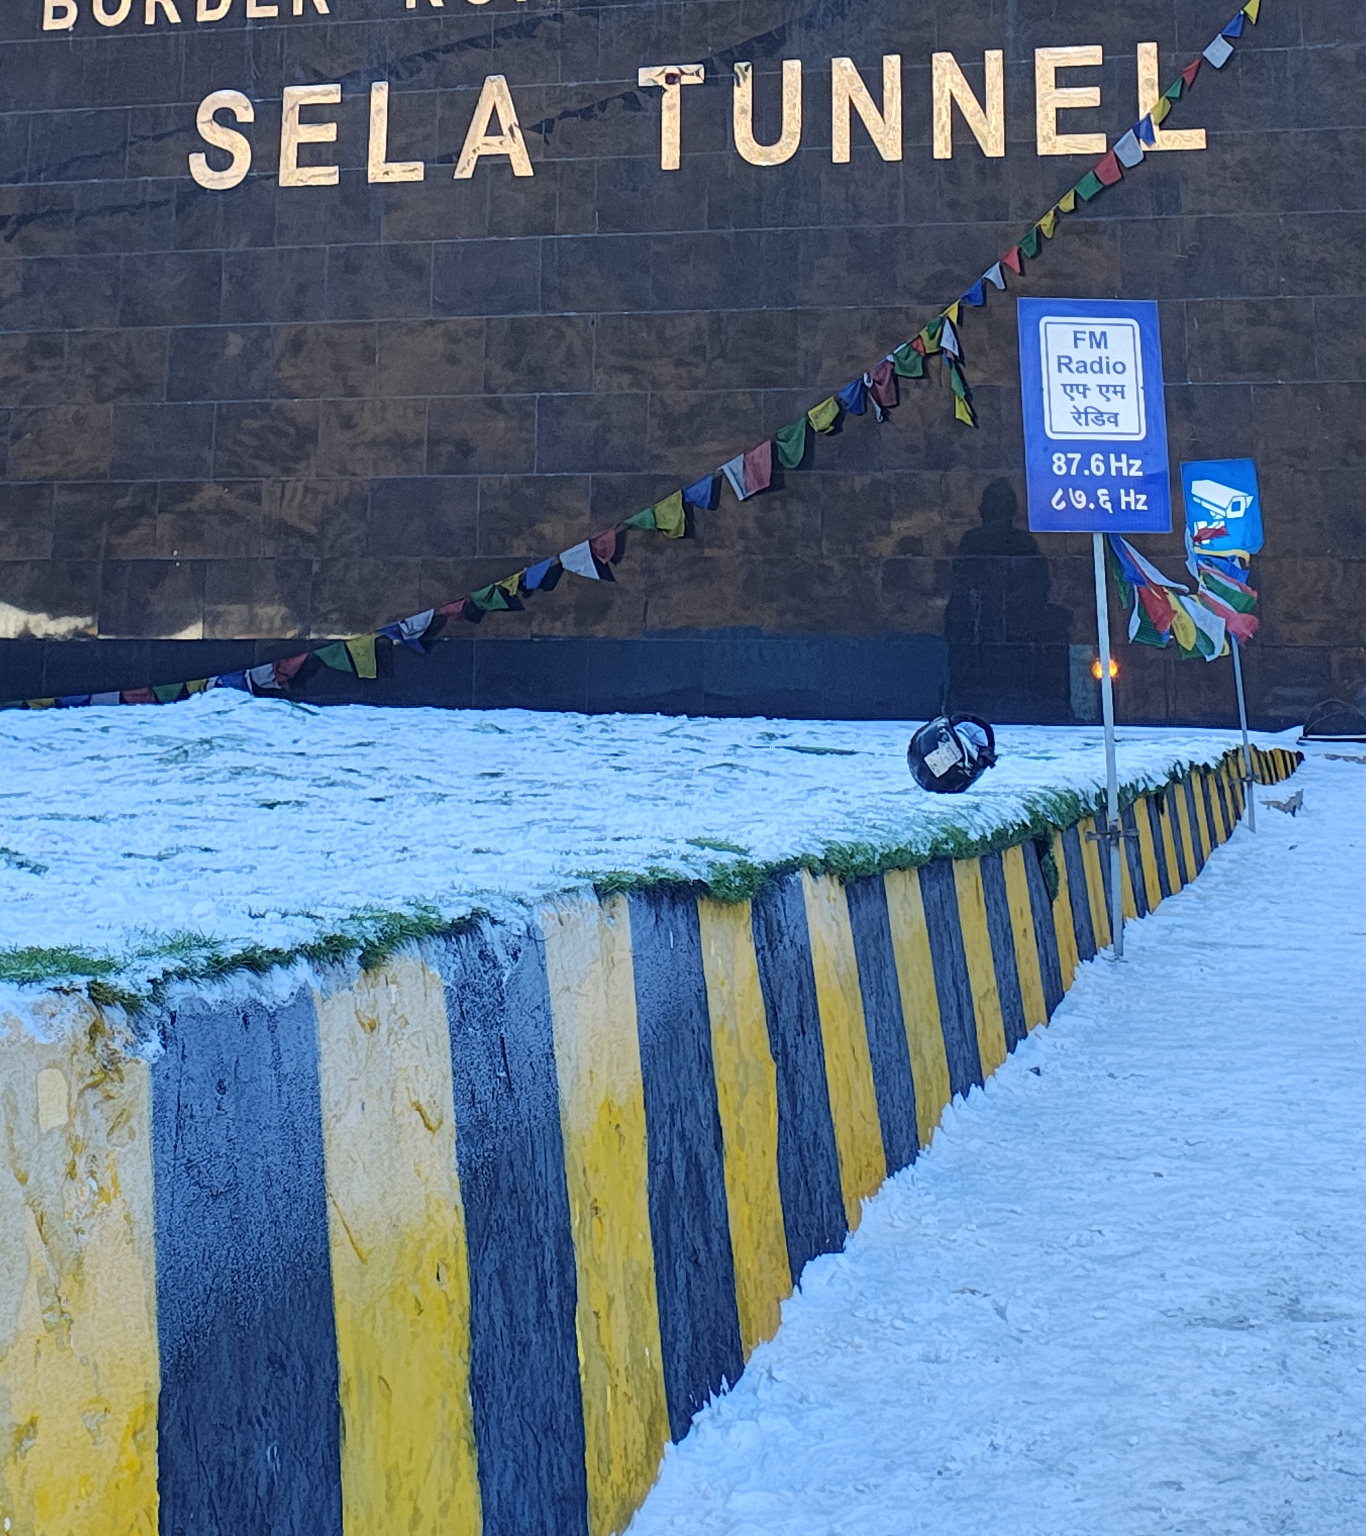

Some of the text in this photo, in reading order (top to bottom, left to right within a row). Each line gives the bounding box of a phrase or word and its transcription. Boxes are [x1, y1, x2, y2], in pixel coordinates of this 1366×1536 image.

[187, 41, 1207, 191] SELA TUNNEL
[1073, 330, 1108, 350] FM
[1057, 355, 1127, 375] Radio
[1060, 383, 1126, 402] एफ एम
[1052, 452, 1143, 477] 87.6 Hz
[1051, 487, 1148, 514] ८७.६ Hz
